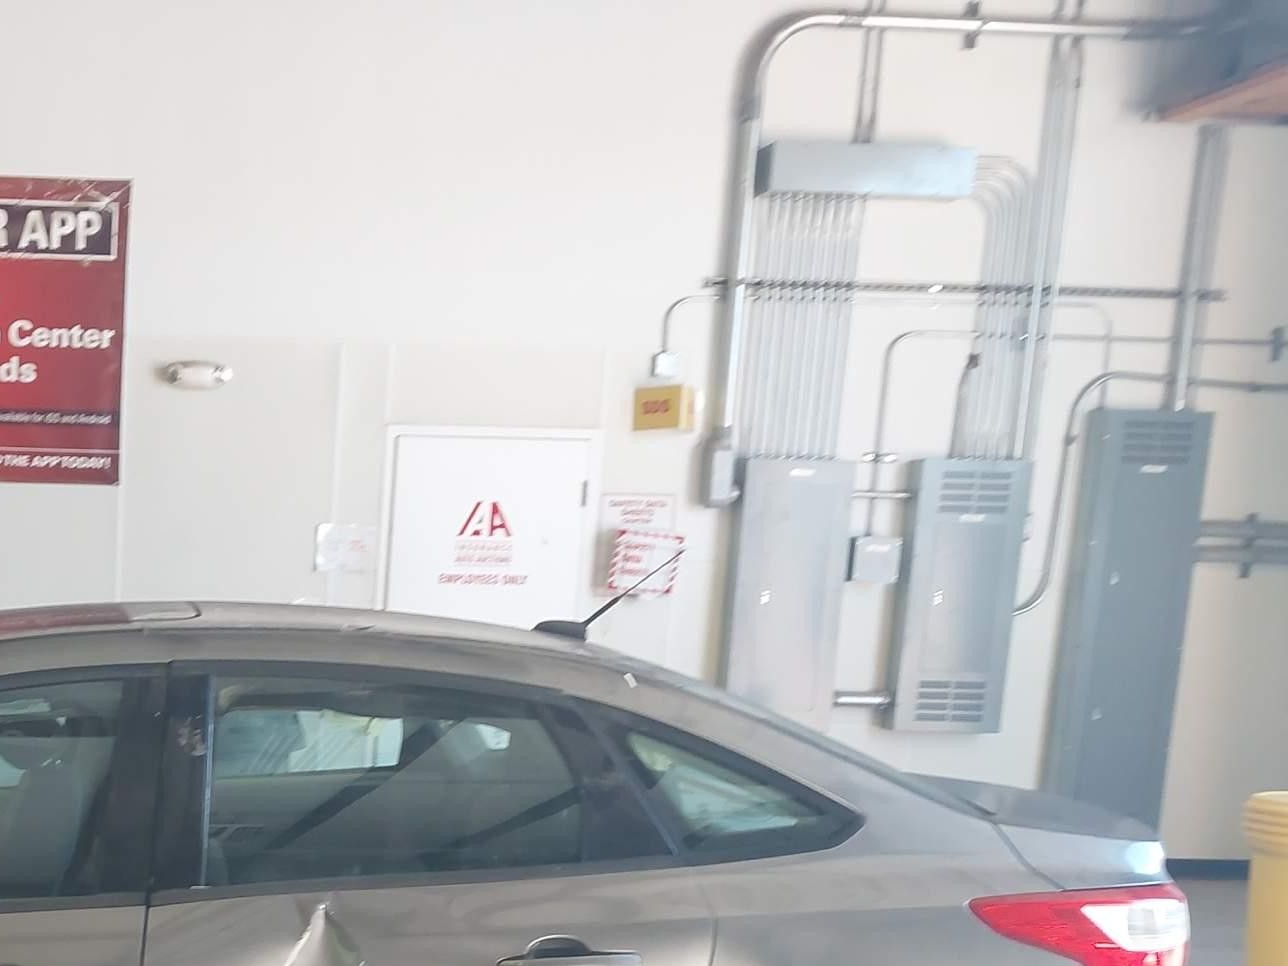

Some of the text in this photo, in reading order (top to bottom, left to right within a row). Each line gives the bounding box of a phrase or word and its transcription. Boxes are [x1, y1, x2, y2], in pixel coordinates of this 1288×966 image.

[17, 209, 103, 251] APP
[8, 319, 115, 349] Center
[4, 454, 31, 467] THE
[30, 455, 62, 468] APP
[438, 572, 529, 586] EMPLOYEES ONLY
